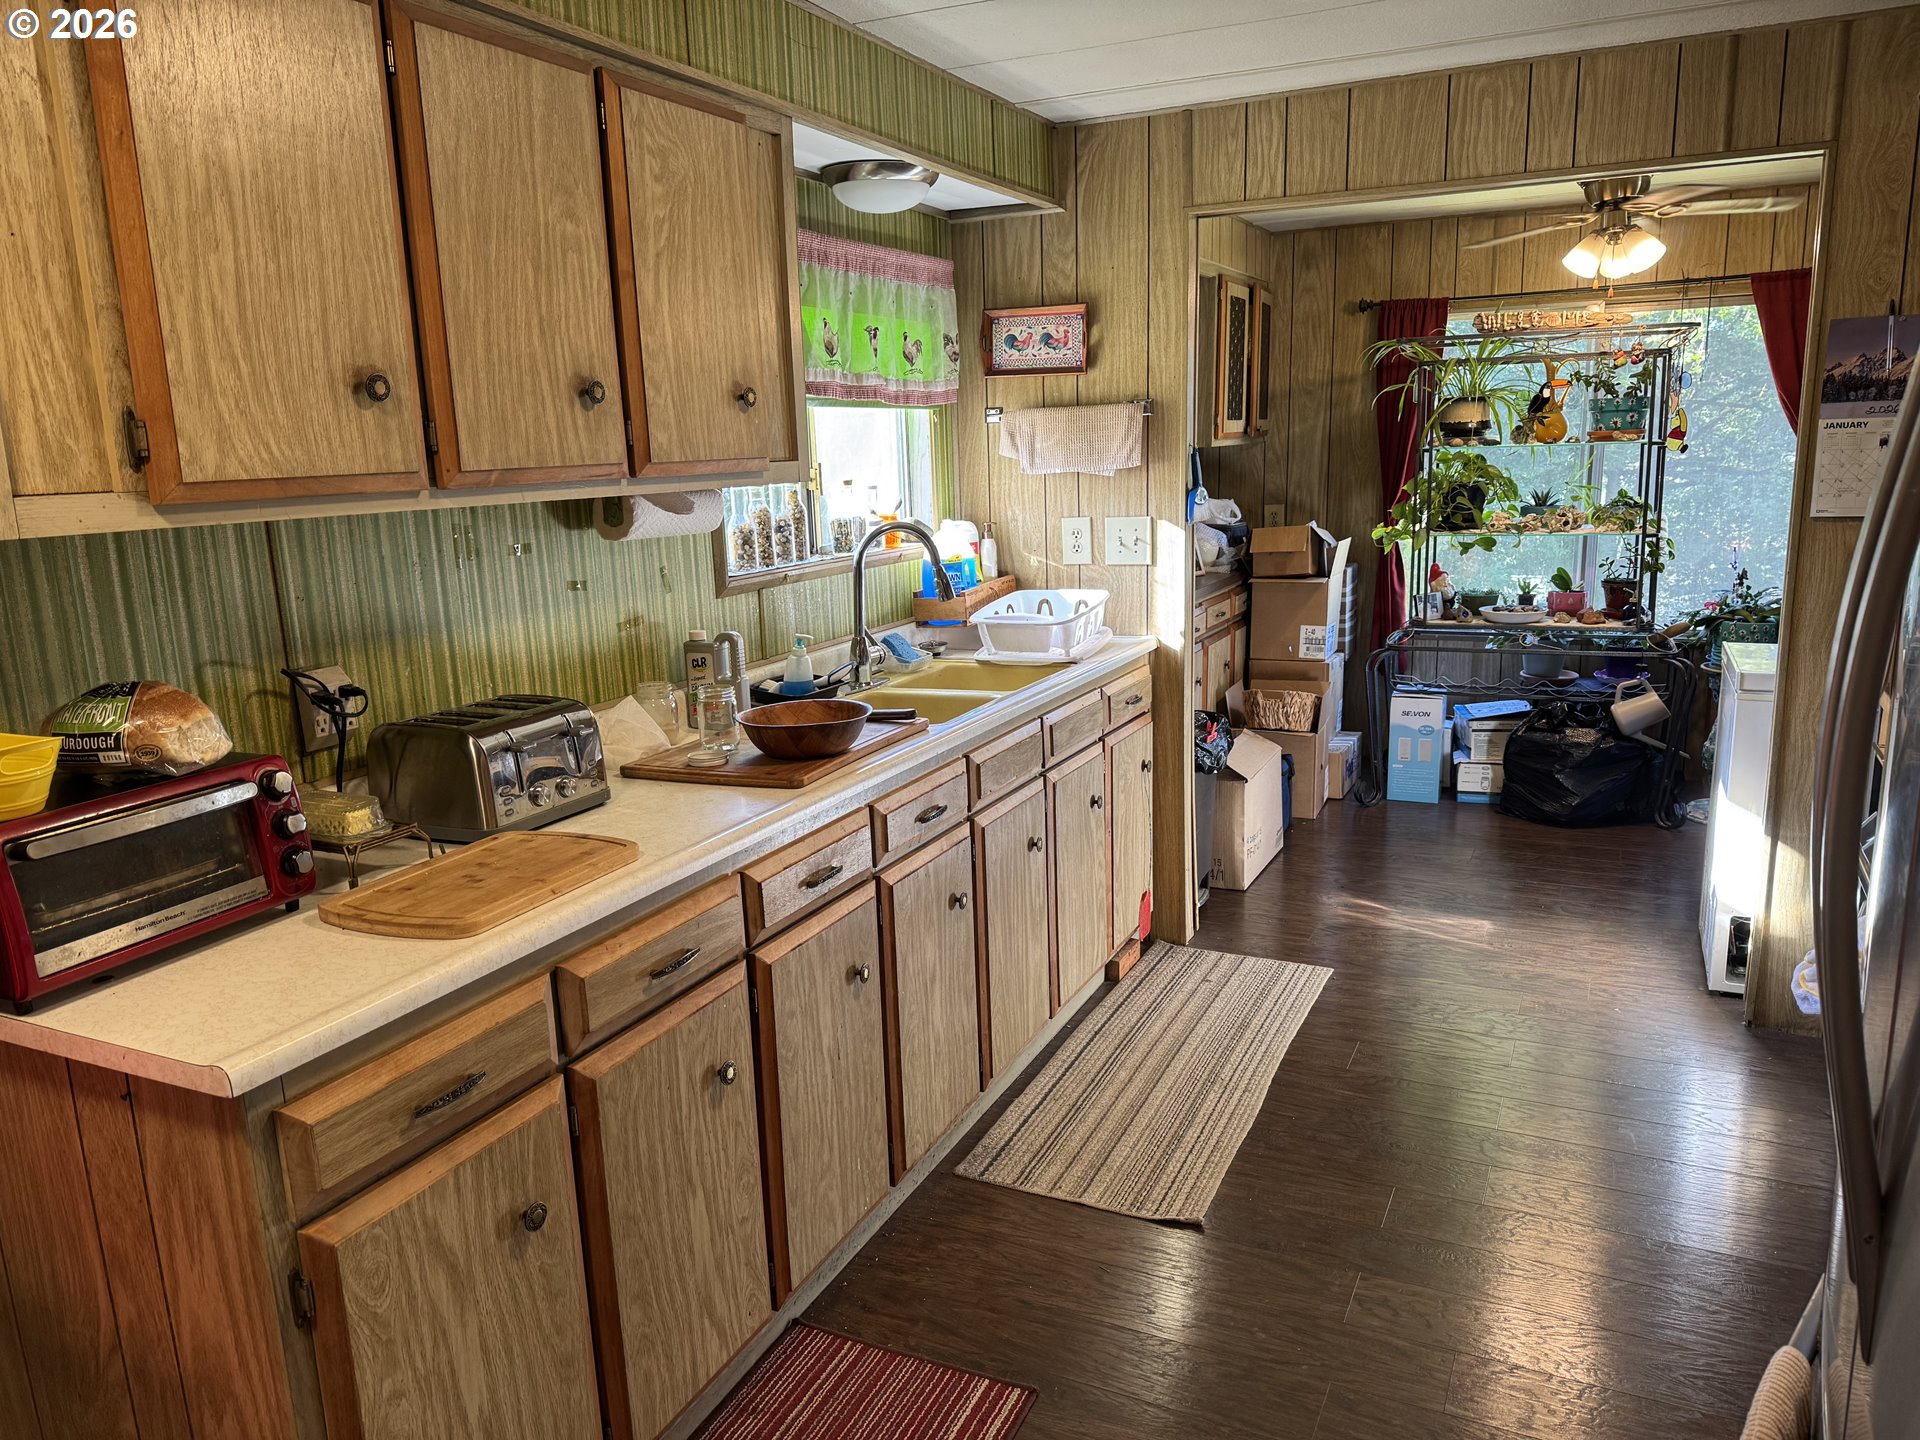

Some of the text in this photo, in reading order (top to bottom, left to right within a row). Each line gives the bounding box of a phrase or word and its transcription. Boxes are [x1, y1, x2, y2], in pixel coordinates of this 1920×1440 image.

[1823, 421, 1870, 430] JANUARY
[691, 656, 707, 669] CLR
[59, 736, 115, 751] URDOUGH
[135, 910, 185, 933] Hamilton Beach
